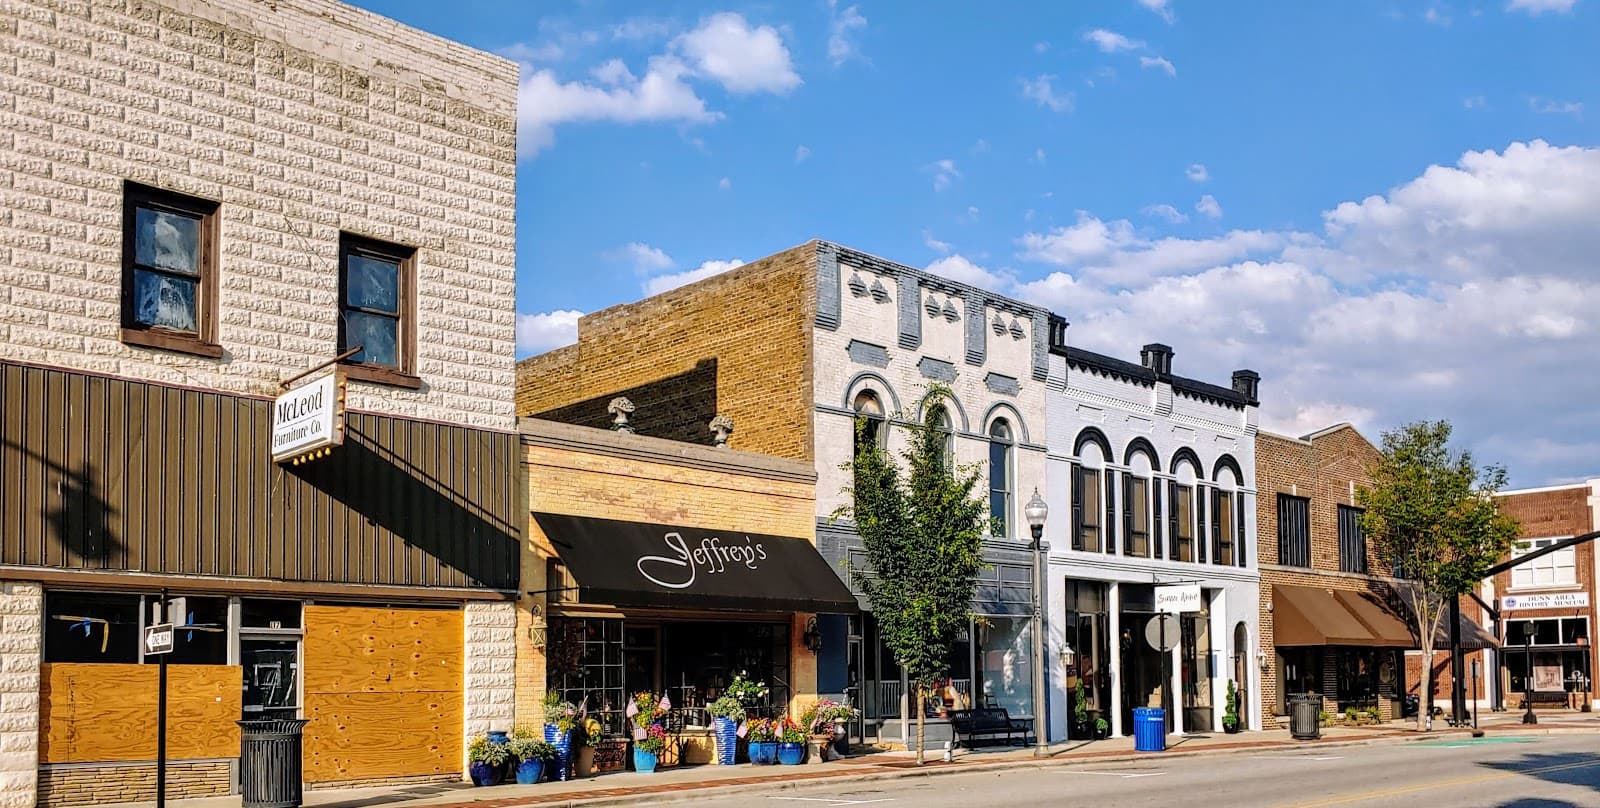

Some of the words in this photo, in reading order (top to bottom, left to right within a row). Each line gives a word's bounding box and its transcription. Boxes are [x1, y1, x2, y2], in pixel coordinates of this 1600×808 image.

[276, 384, 323, 426] McLeod
[274, 425, 309, 448] Furniture
[310, 419, 322, 435] Co.
[637, 532, 767, 589] Jeffrey's
